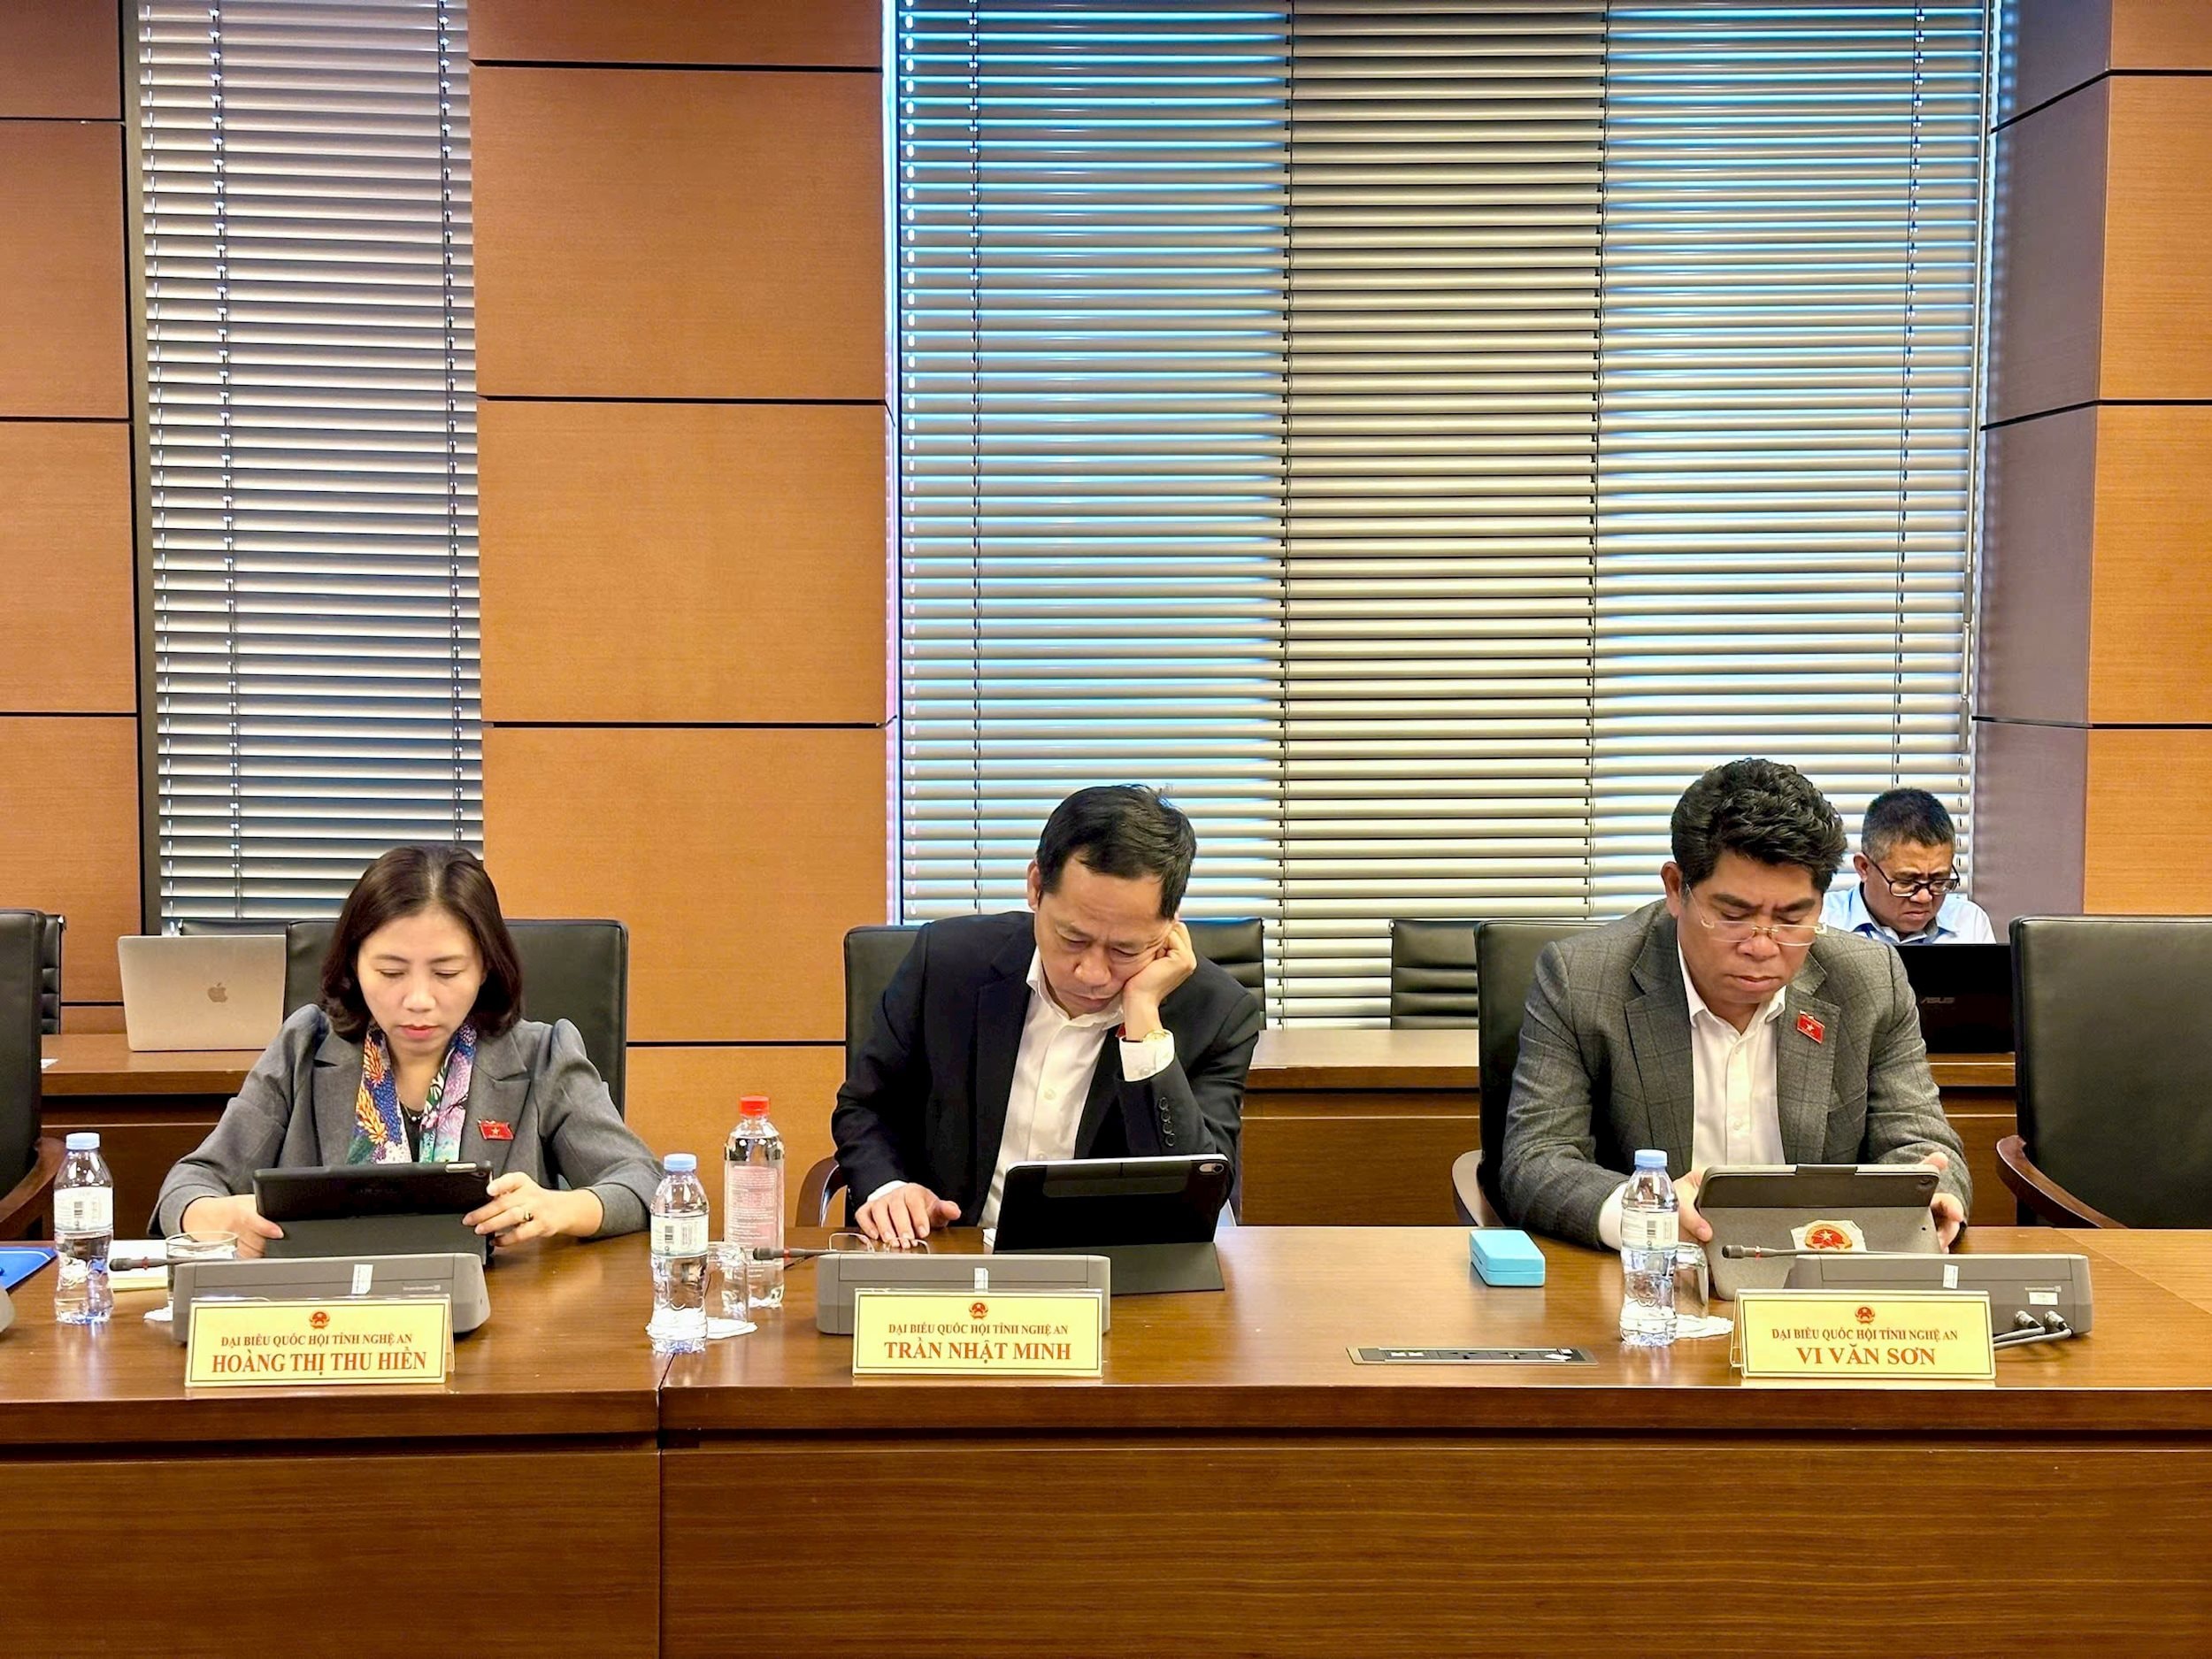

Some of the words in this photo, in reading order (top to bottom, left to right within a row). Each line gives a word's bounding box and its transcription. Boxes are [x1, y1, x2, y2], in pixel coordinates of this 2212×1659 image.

[971, 1323, 991, 1336] HỘI
[1021, 1324, 1051, 1337] NGHỆ
[1054, 1325, 1069, 1335] AN
[1856, 1328, 1877, 1342] HỘI
[1909, 1329, 1940, 1343] NGHỆ
[1942, 1330, 1958, 1340] AN
[309, 1333, 329, 1347] HỘI
[362, 1333, 396, 1346] NGHỆ
[396, 1333, 412, 1344] AN
[949, 1340, 1009, 1364] NHẬT
[1012, 1343, 1071, 1360] MINH
[1796, 1348, 1823, 1364] VI
[1828, 1343, 1879, 1365] VĂN
[1887, 1346, 1936, 1365] SƠN
[211, 1349, 285, 1372] HOÀNG
[290, 1353, 325, 1375] THỊ
[331, 1352, 372, 1371] THU
